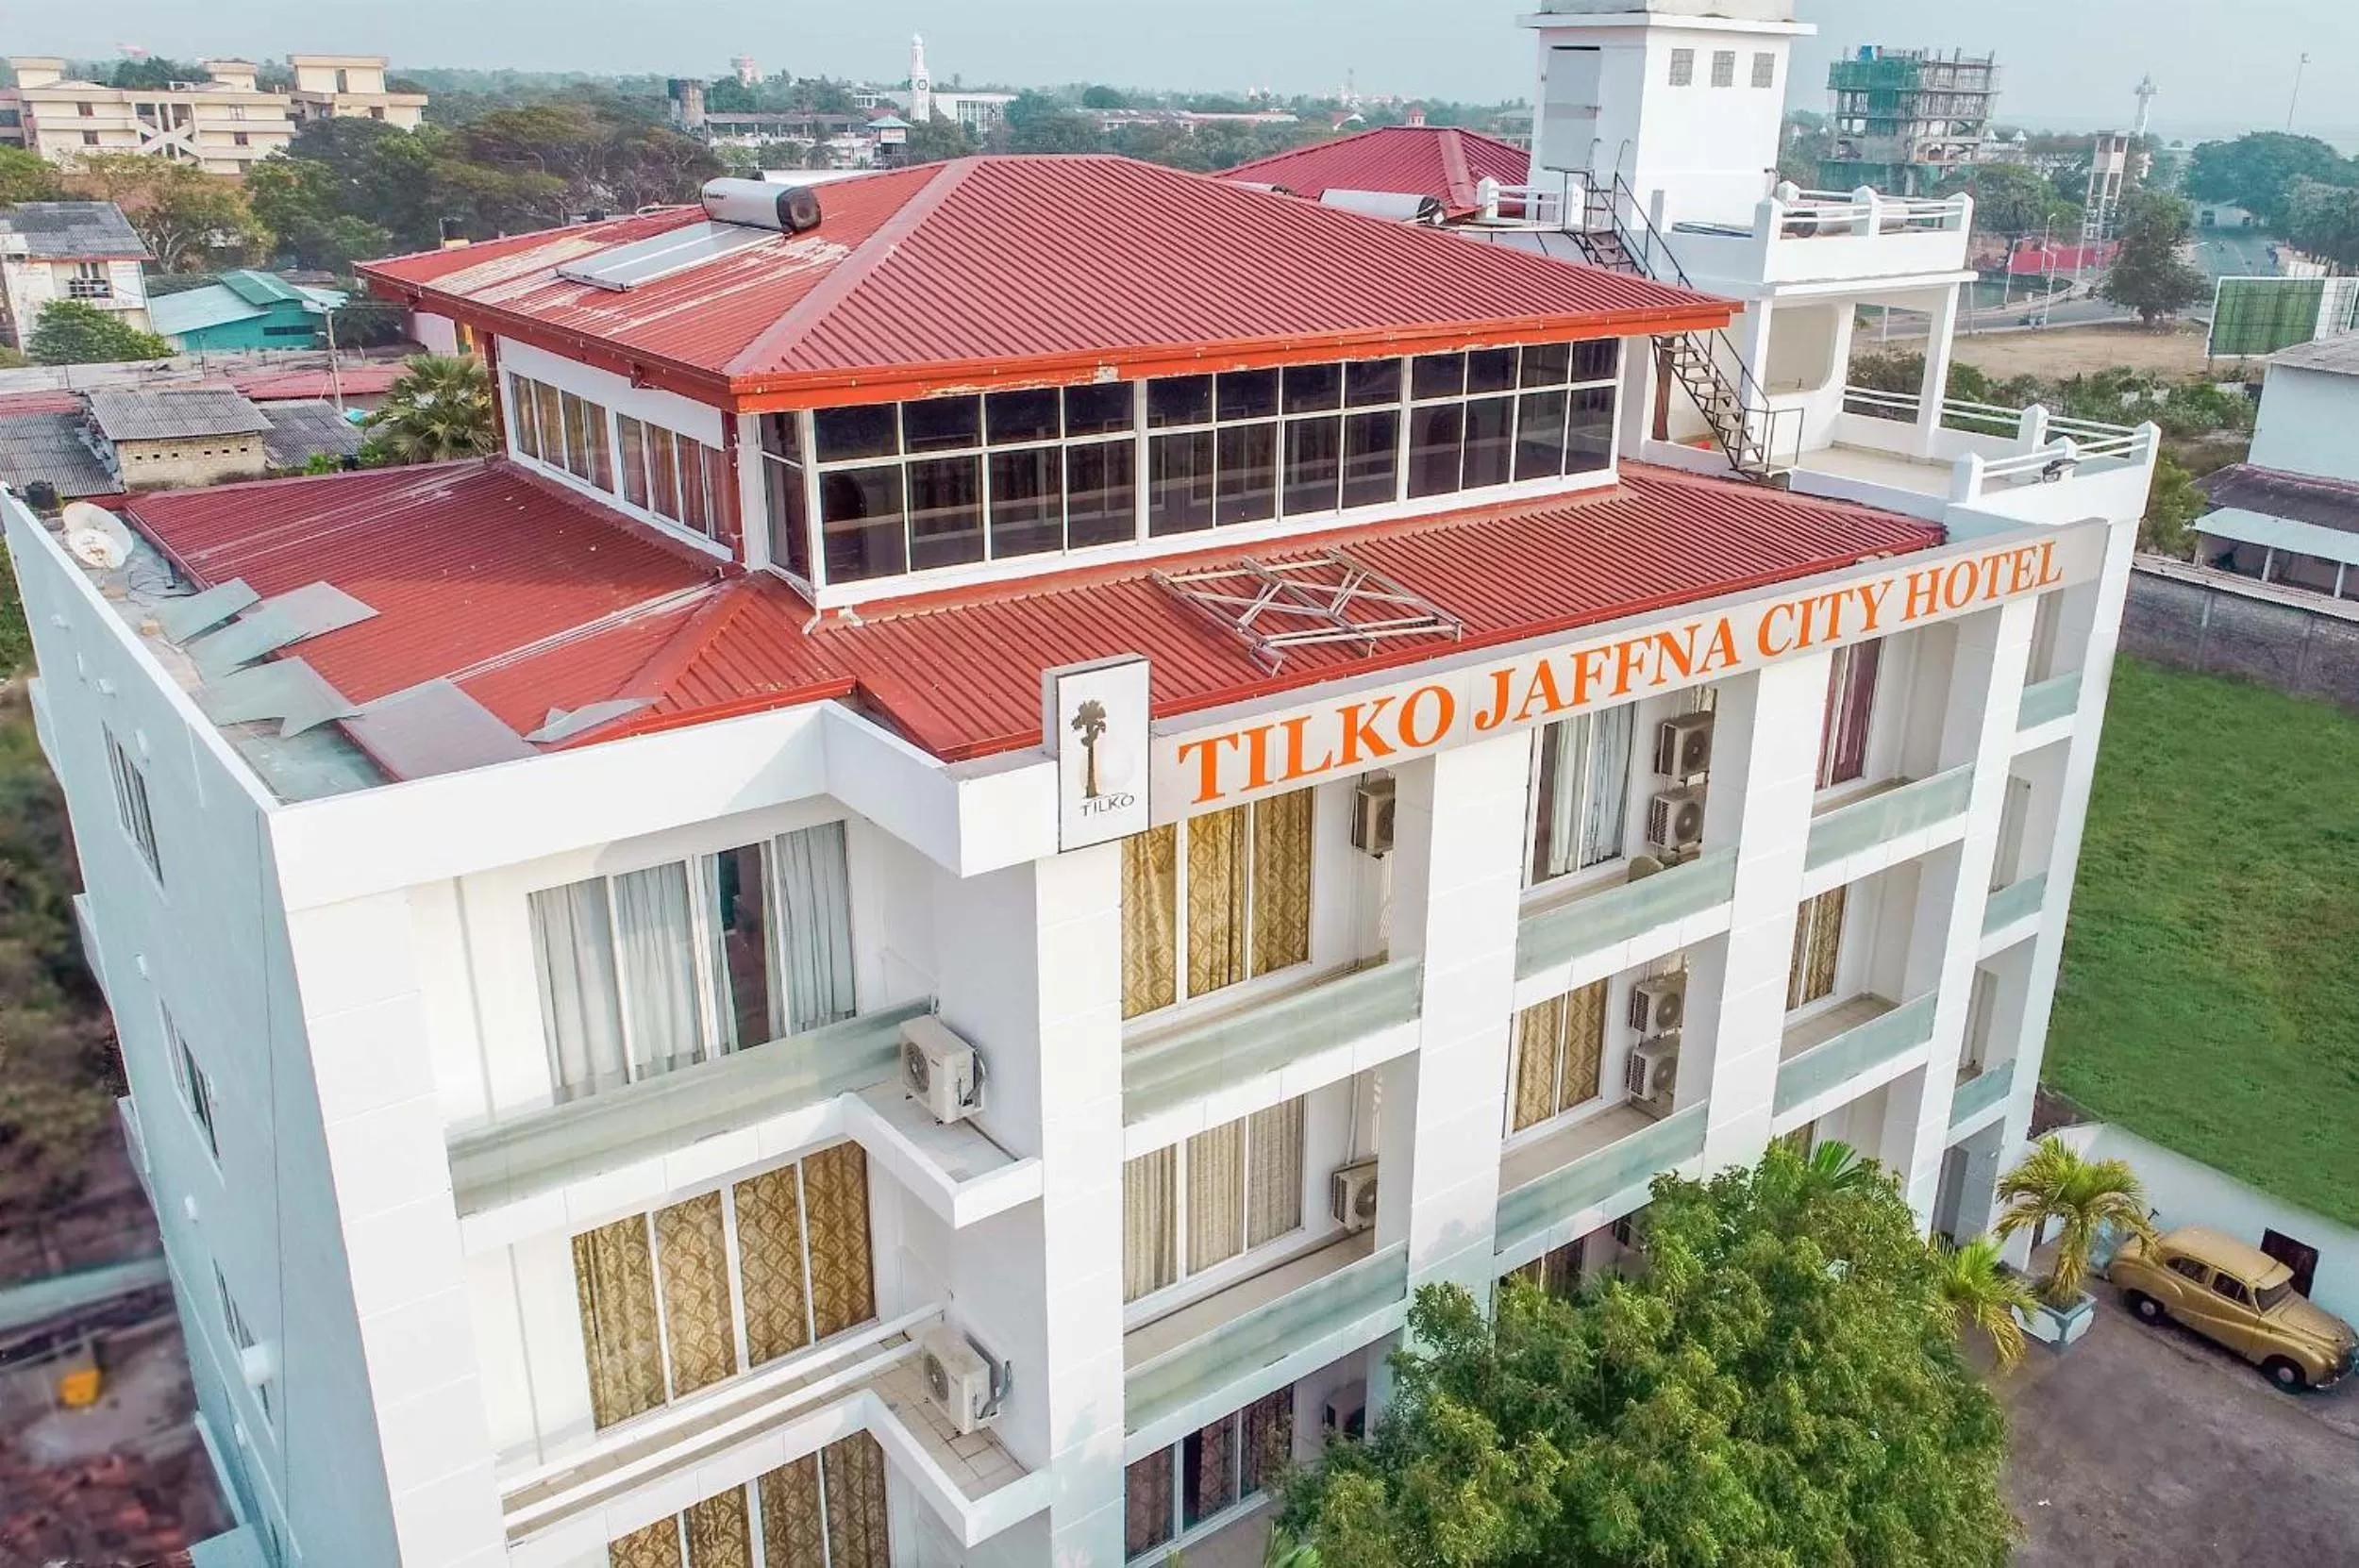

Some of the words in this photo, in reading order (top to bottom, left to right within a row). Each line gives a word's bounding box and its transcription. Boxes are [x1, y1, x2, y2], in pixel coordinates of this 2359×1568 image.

[1178, 685, 1455, 805] TILKO
[1475, 617, 1740, 732] JAFFNA
[1757, 578, 1892, 658] CITY
[1900, 540, 2063, 622] HOTEL
[1080, 794, 1135, 817] TILKO
